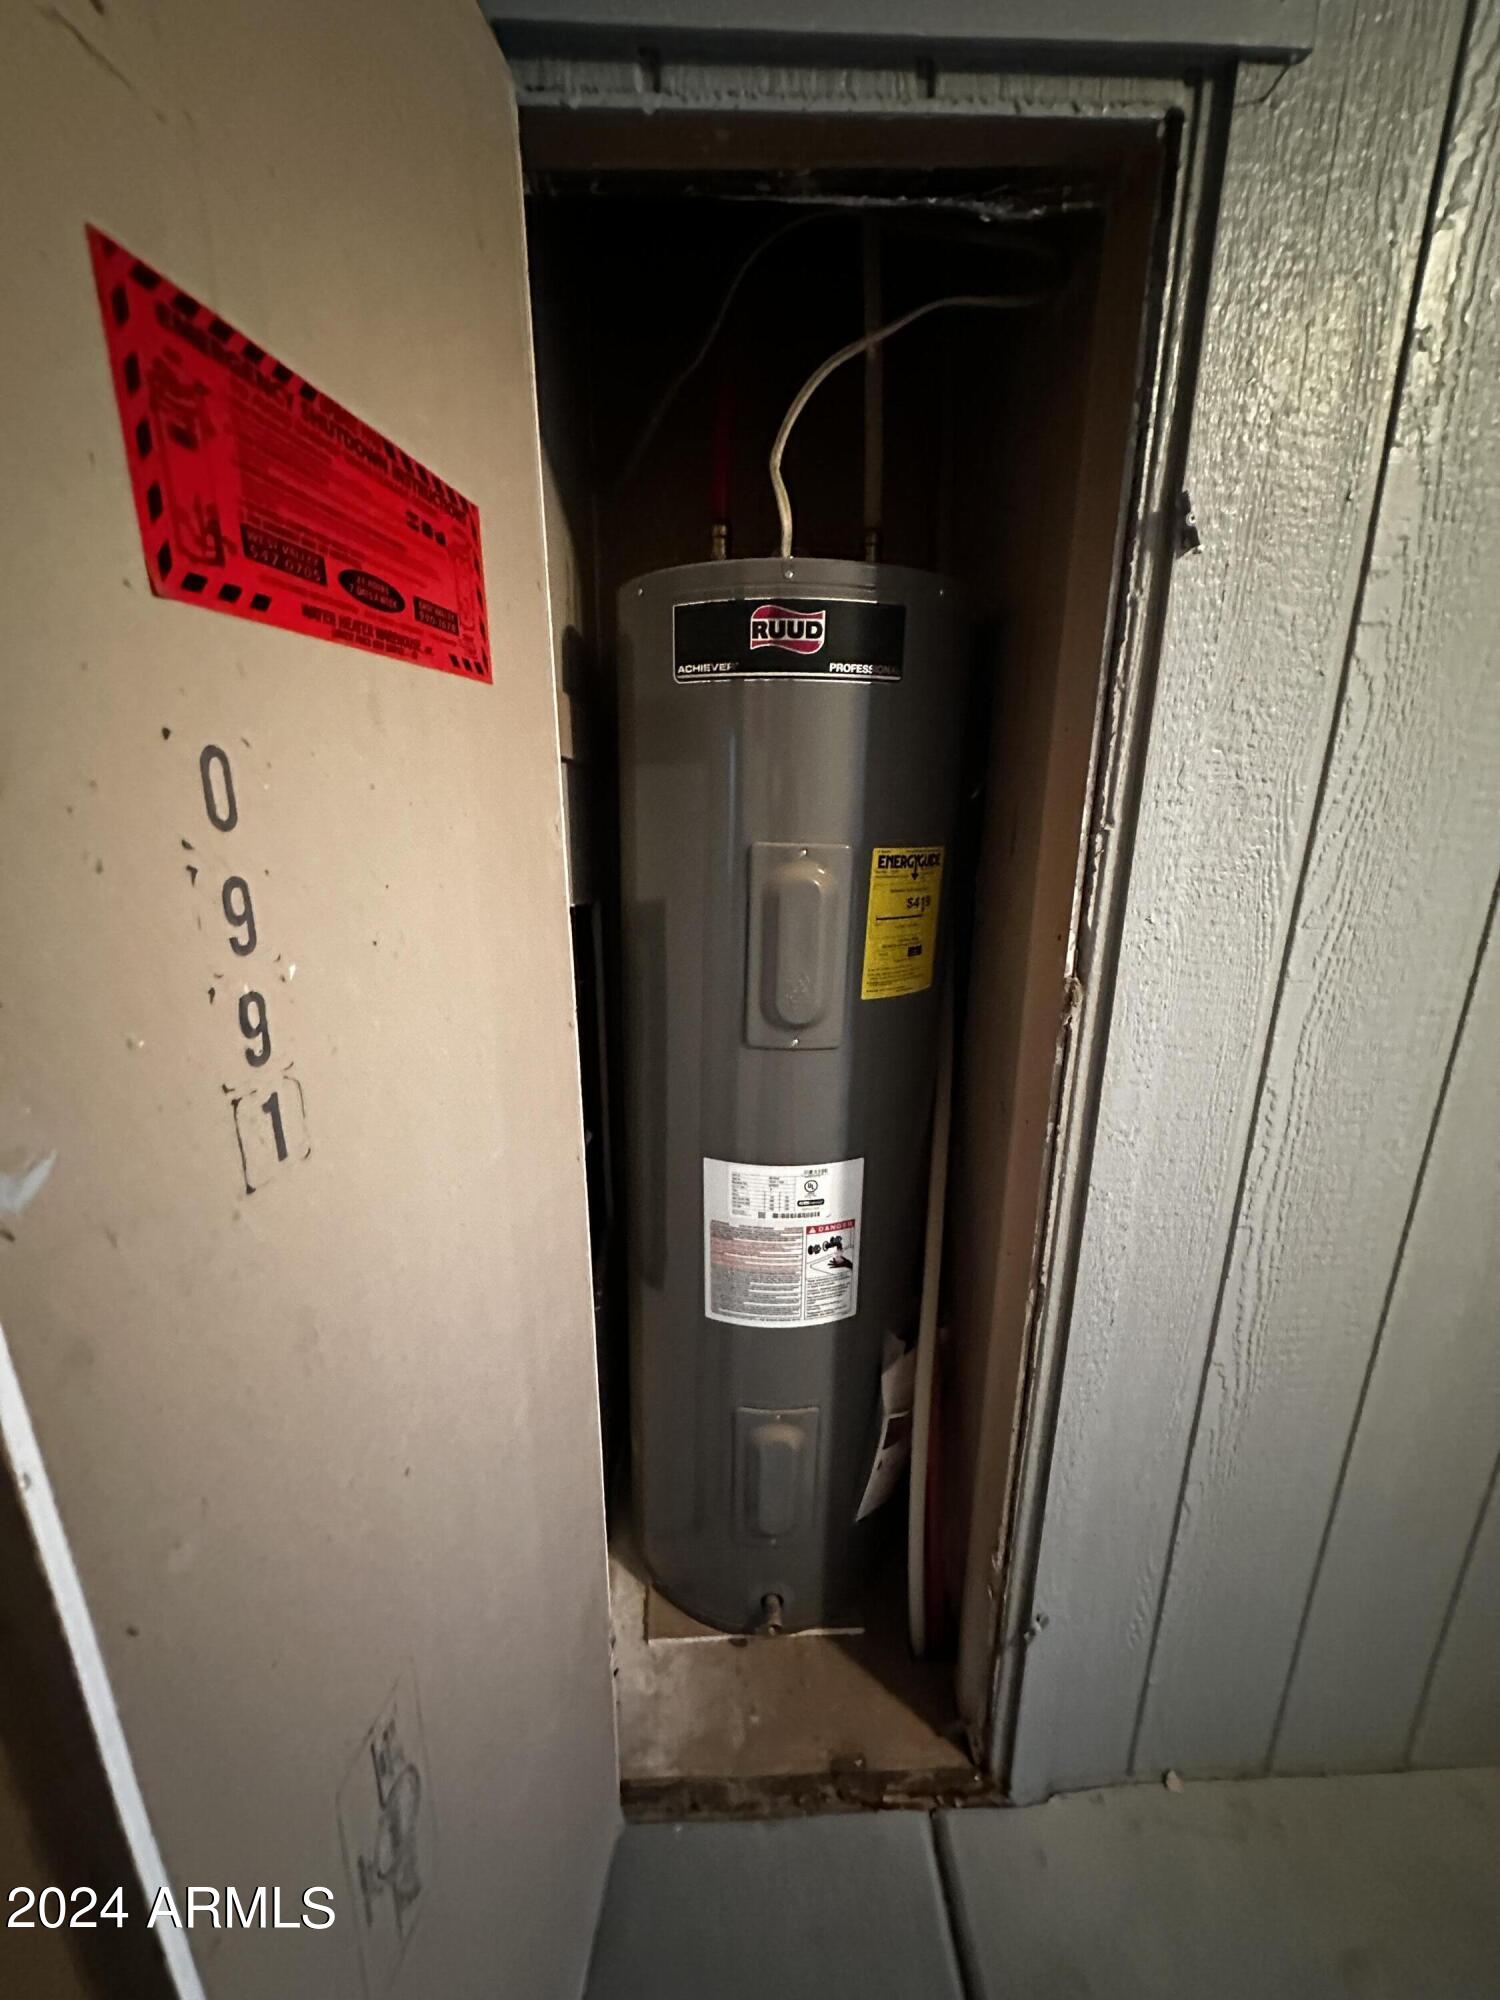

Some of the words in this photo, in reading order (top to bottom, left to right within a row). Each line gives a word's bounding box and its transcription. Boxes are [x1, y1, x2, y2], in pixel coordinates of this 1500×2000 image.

[751, 620, 824, 640] RUUD
[677, 662, 739, 675] ACHIEVER
[818, 1220, 853, 1233] DANGER
